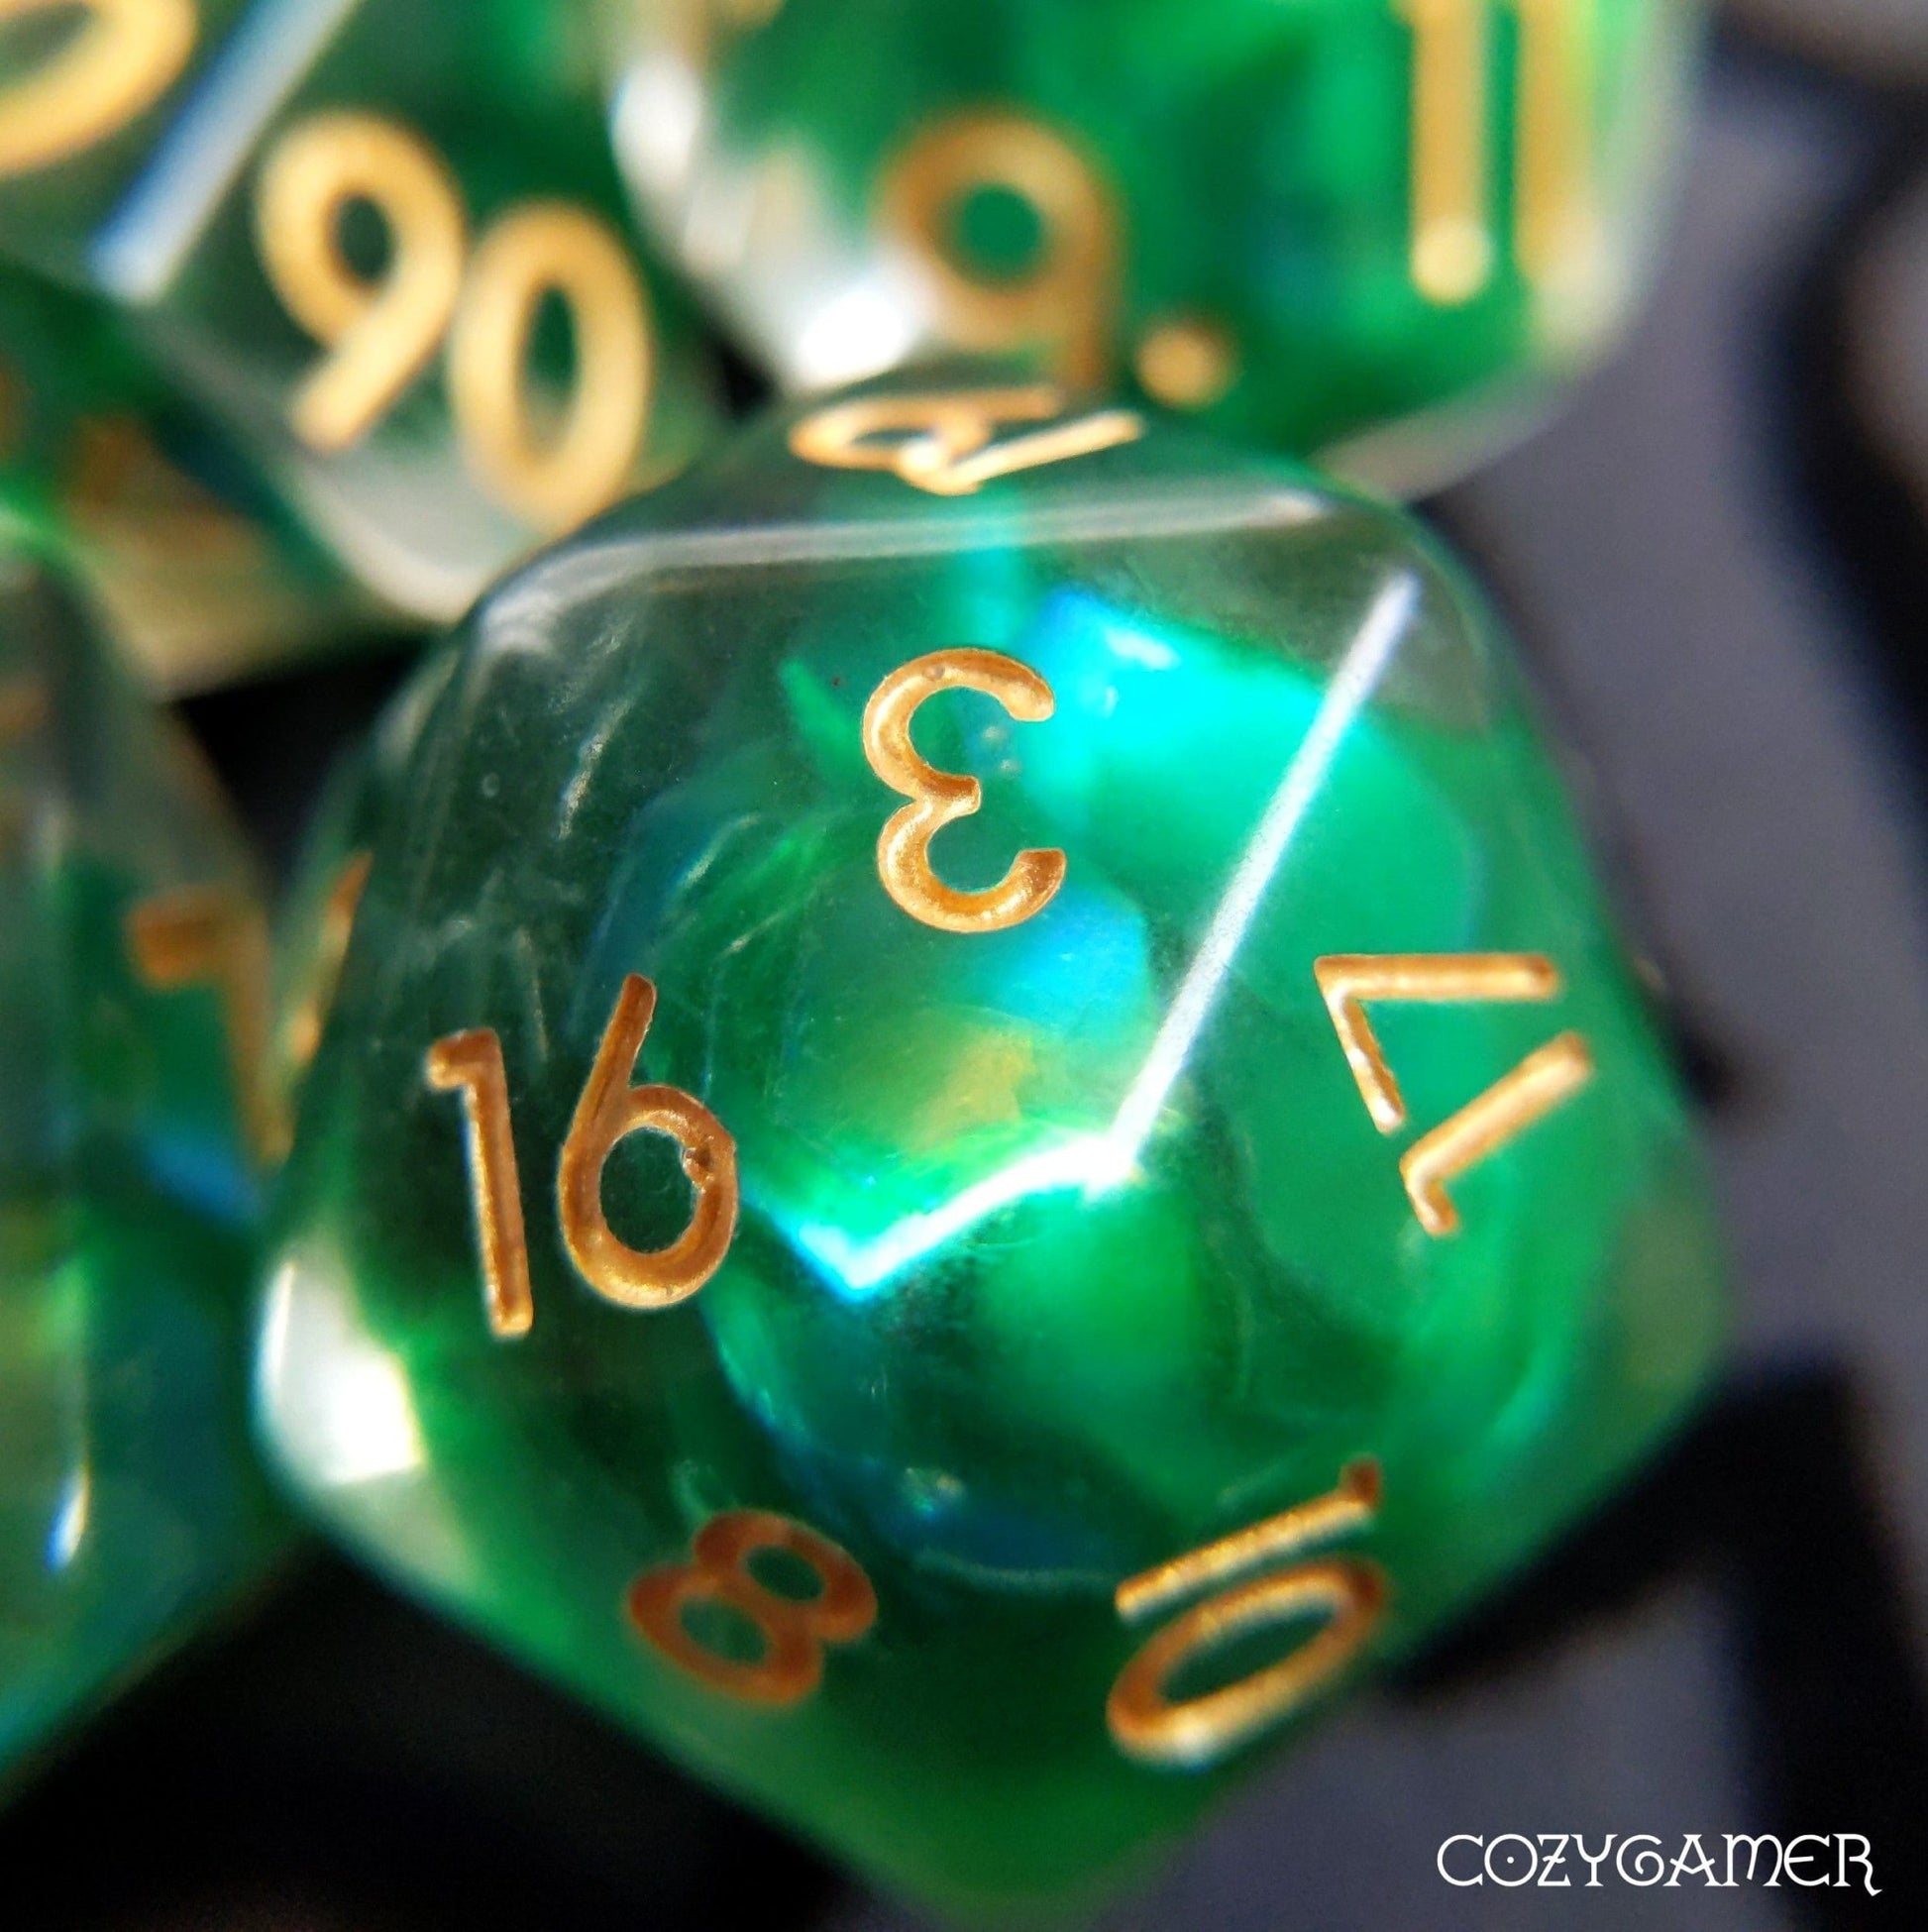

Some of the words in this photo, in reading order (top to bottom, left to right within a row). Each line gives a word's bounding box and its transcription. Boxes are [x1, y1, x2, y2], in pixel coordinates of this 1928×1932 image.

[256, 113, 654, 535] 90
[862, 648, 1067, 933] 3
[427, 973, 738, 1337] 16
[1314, 953, 1593, 1236] 17
[628, 1510, 879, 1709] 8
[1106, 1456, 1385, 1768] 10
